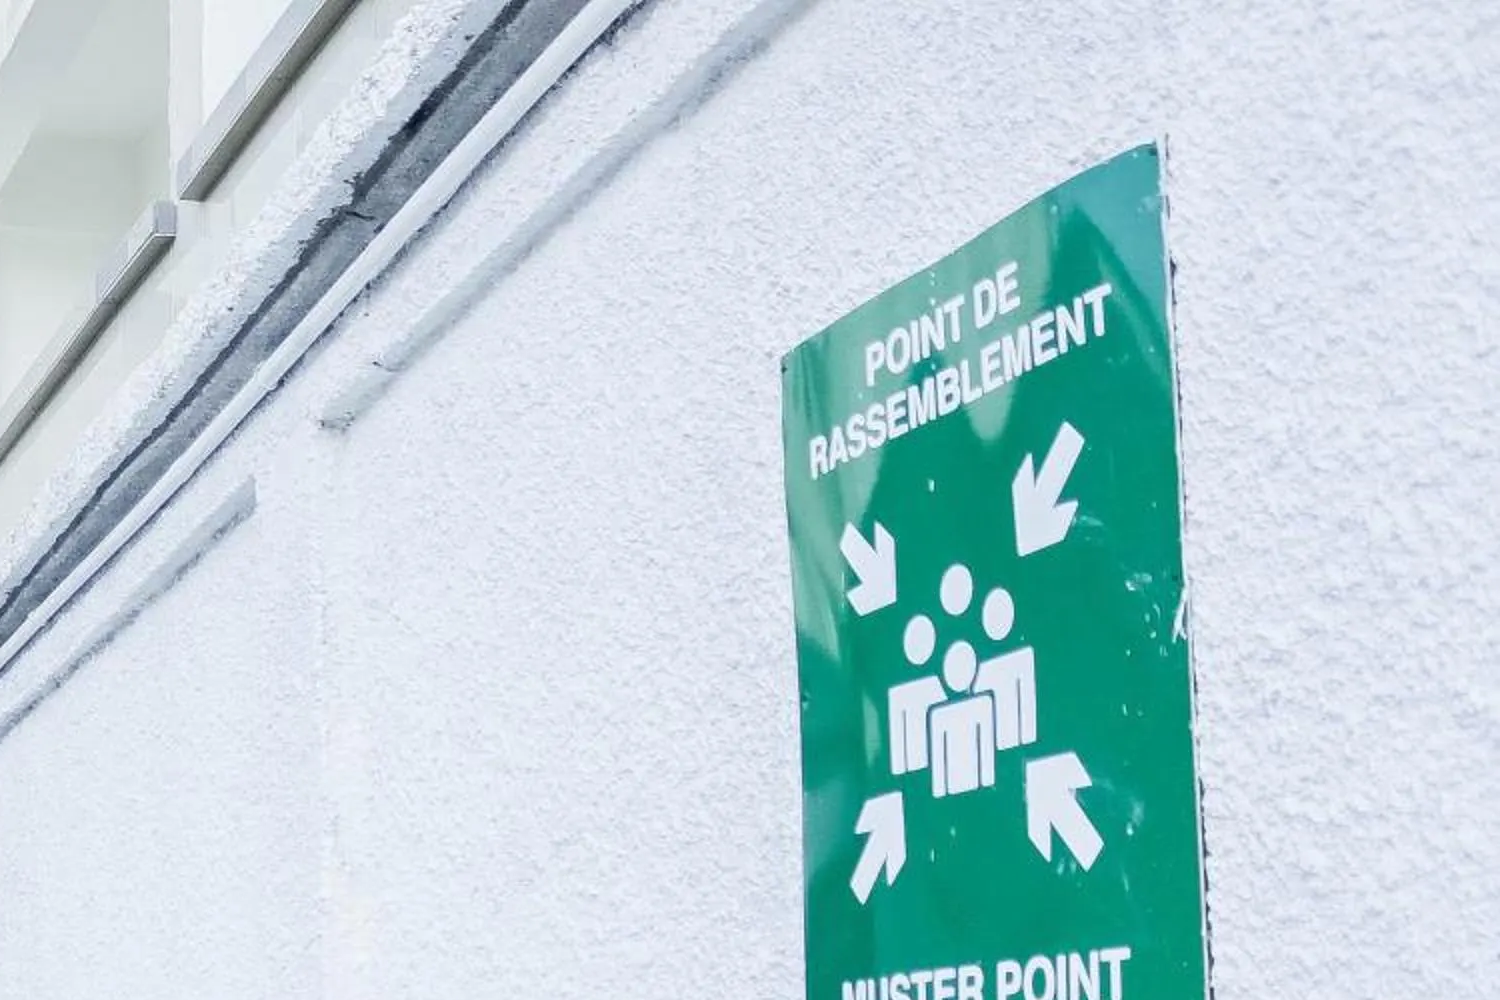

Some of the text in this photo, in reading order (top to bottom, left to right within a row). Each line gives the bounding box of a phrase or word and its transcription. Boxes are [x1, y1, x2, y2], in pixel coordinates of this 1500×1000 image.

[809, 283, 1112, 479] RASSEMBLEMENT
[865, 262, 1020, 386] POINT DE
